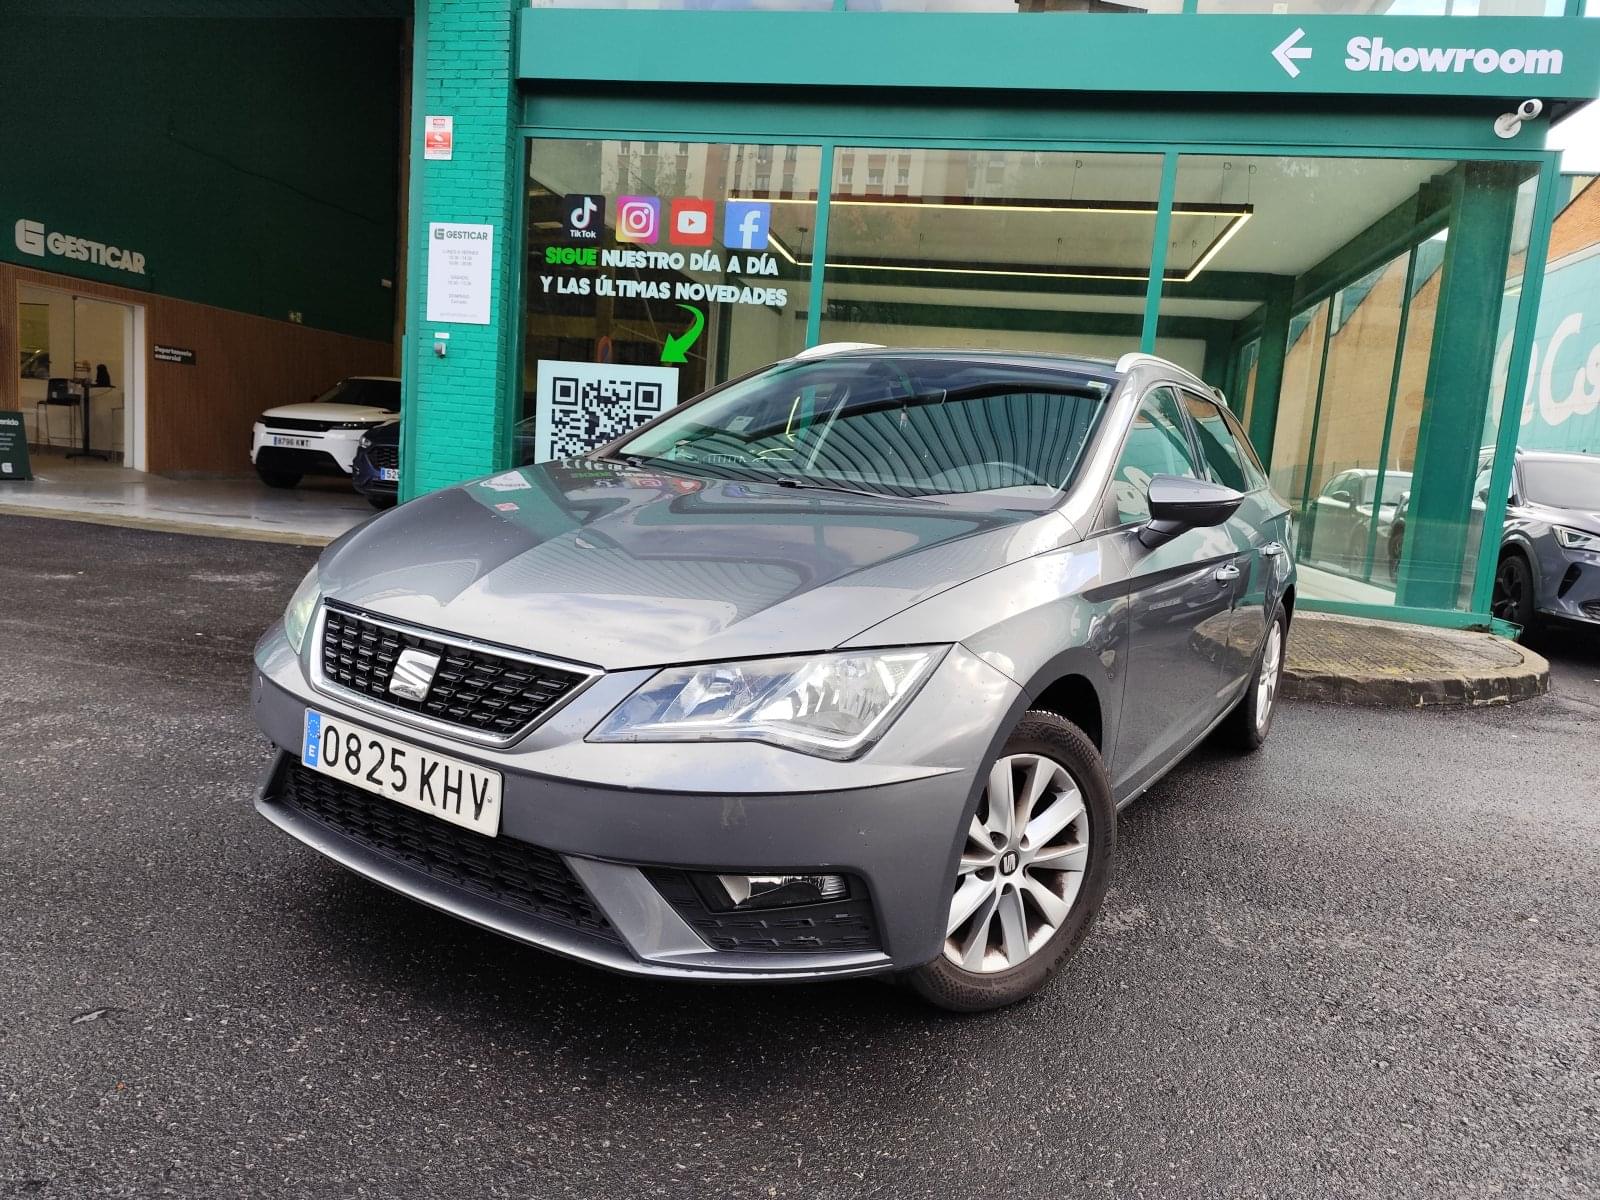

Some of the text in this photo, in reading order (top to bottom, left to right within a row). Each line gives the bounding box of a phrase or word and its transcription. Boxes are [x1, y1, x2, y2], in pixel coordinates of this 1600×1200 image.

[1344, 36, 1564, 75] Showroom
[446, 230, 488, 241] GESTICAR
[569, 229, 598, 239] TikTok
[46, 231, 146, 275] GESTICAR
[545, 246, 779, 276] SIGUE NUESTRO DÍA A DÍA
[539, 274, 788, 307] Y LAS ÚLTIMAS NOVEDADES
[309, 745, 316, 757] E
[322, 725, 489, 821] 0825 KHV
